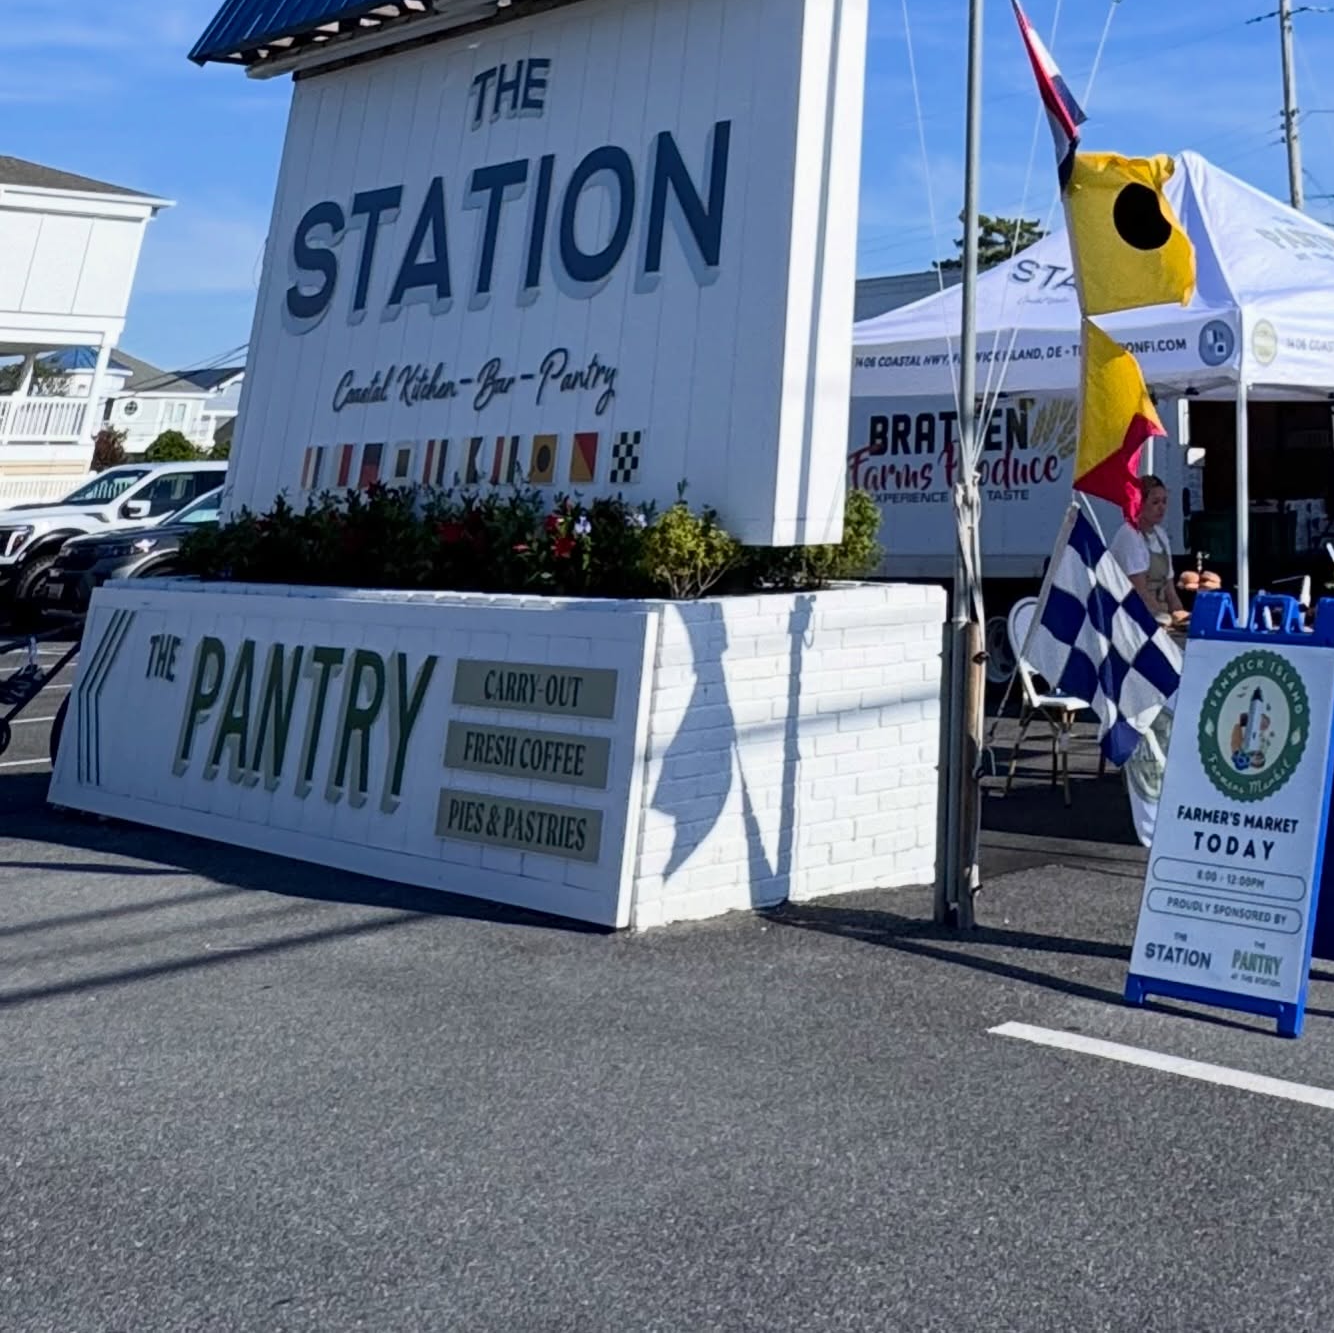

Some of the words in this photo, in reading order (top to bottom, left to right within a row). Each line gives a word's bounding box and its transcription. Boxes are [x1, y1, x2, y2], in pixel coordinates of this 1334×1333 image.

[473, 58, 551, 122] THE
[286, 120, 731, 319] STATION
[878, 355, 920, 367] COASTAL
[952, 349, 1000, 365] FWICK
[1047, 345, 1062, 359] DE
[333, 365, 396, 412] Coastal
[396, 361, 458, 407] Kitchen
[473, 357, 515, 411] Bar
[536, 347, 618, 416] Pantry
[870, 407, 1028, 456] BRATEN
[848, 443, 933, 490] Farms
[937, 439, 1063, 489] Poduce
[874, 491, 949, 504] XPERIENCE
[987, 489, 1029, 502] TASTE
[146, 633, 182, 683] THE
[484, 669, 583, 708] CARRY-OUT
[1210, 659, 1264, 708] FENWICK
[1270, 661, 1304, 715] ISLAND
[179, 636, 440, 799] PANTRY
[463, 731, 517, 767] FRESH
[520, 737, 587, 777] COFFEE
[447, 798, 485, 834] PIES
[486, 804, 500, 837] &
[502, 807, 588, 852] PASTRIES
[1177, 805, 1240, 827] FARMER'S
[1243, 814, 1299, 834] MARKET
[1193, 831, 1275, 861] TODAY
[1167, 896, 1210, 912] PROUDLY
[1213, 904, 1271, 923] SPONSORED
[1274, 913, 1287, 925] BY
[1144, 941, 1212, 970] STATION
[1231, 948, 1283, 976] PANTRY
